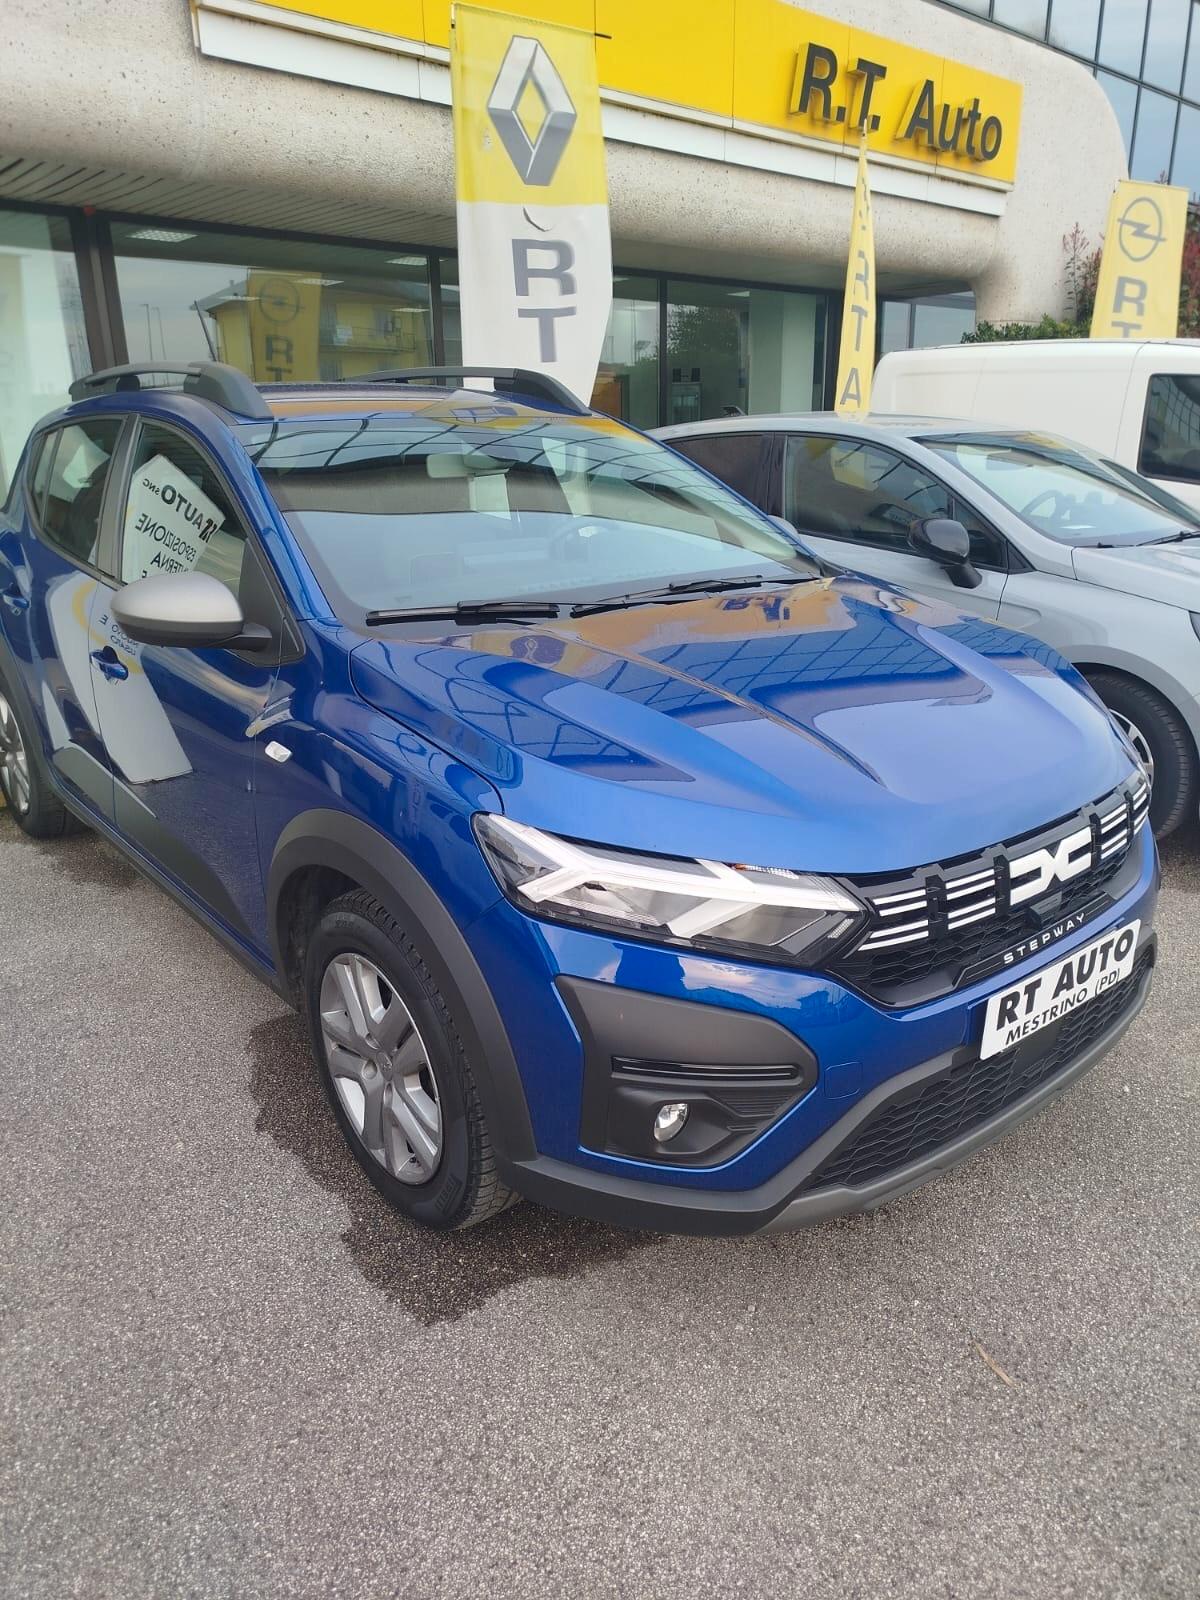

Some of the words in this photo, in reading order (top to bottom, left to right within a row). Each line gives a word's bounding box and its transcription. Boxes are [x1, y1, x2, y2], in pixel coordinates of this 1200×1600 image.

[794, 42, 887, 131] R.T.
[904, 79, 1003, 161] Auto
[995, 978, 1042, 1032] RT
[1051, 929, 1135, 1001] AUTO
[1003, 912, 1085, 965] STEPWAY
[1004, 989, 1088, 1046] MESTRINO
[1094, 968, 1121, 996] (PD)
